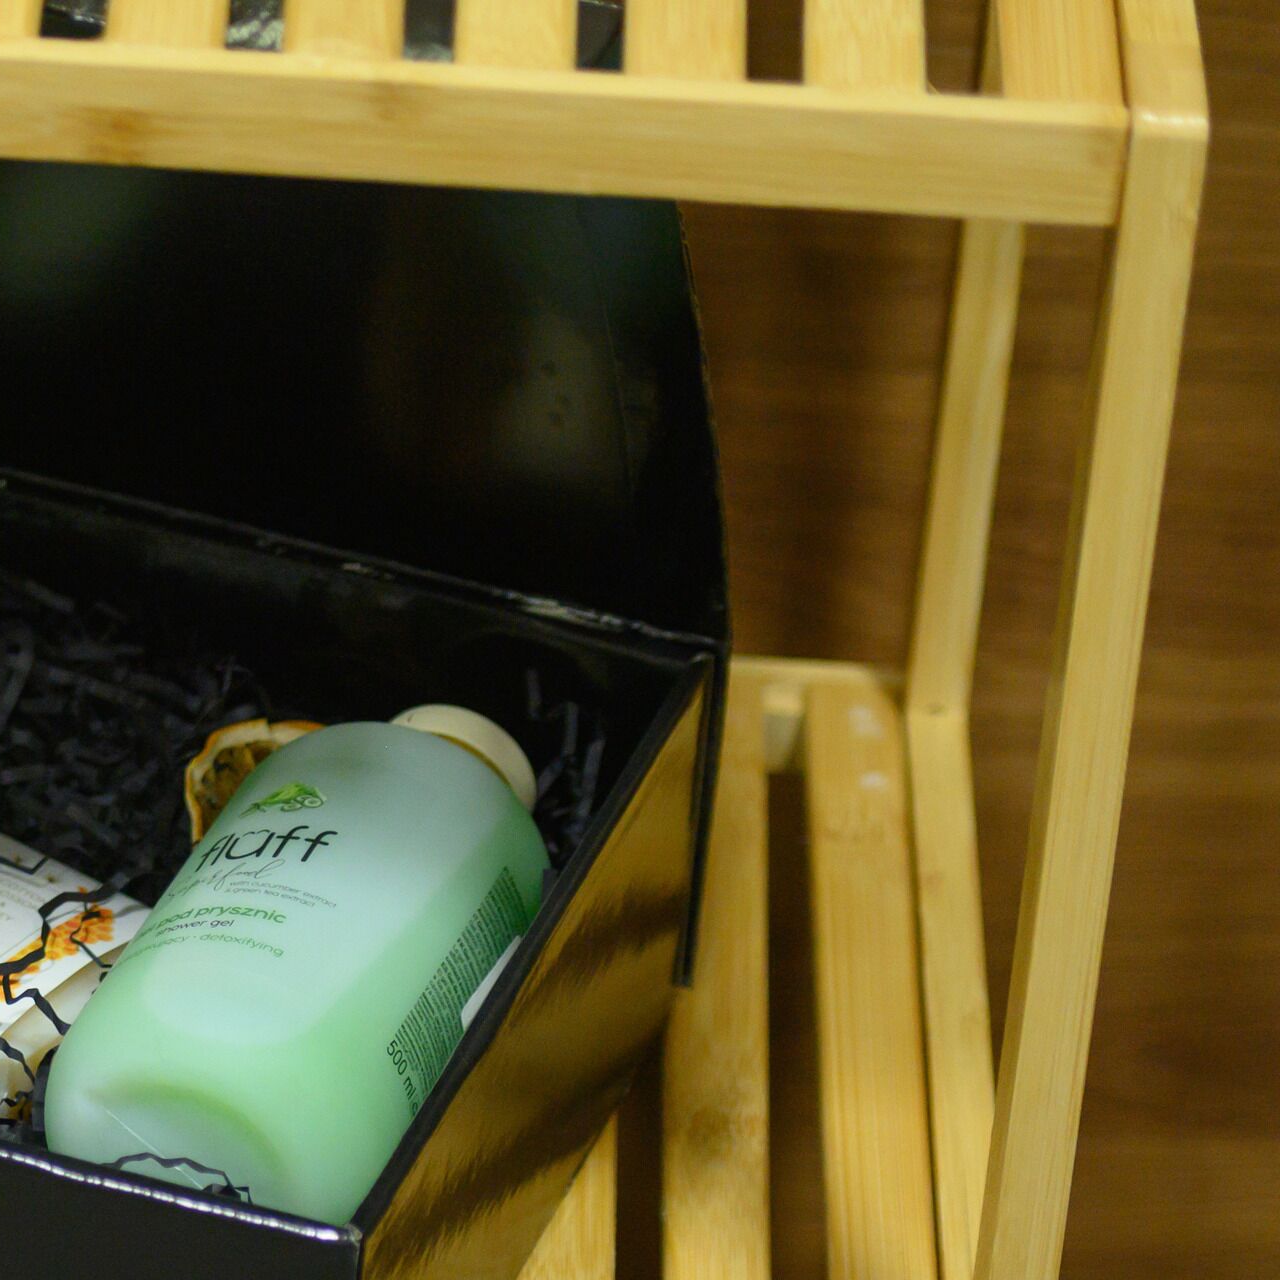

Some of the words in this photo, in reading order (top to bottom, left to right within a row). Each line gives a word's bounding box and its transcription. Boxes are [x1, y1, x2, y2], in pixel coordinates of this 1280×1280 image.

[232, 887, 262, 895] green
[280, 893, 317, 908] extract
[251, 880, 302, 894] cucumber
[303, 891, 337, 909] extract
[193, 905, 288, 925] prysznic
[209, 919, 235, 929] gel
[199, 933, 285, 958] detoxifying
[386, 1039, 408, 1076] 500
[402, 1075, 417, 1101] ml
